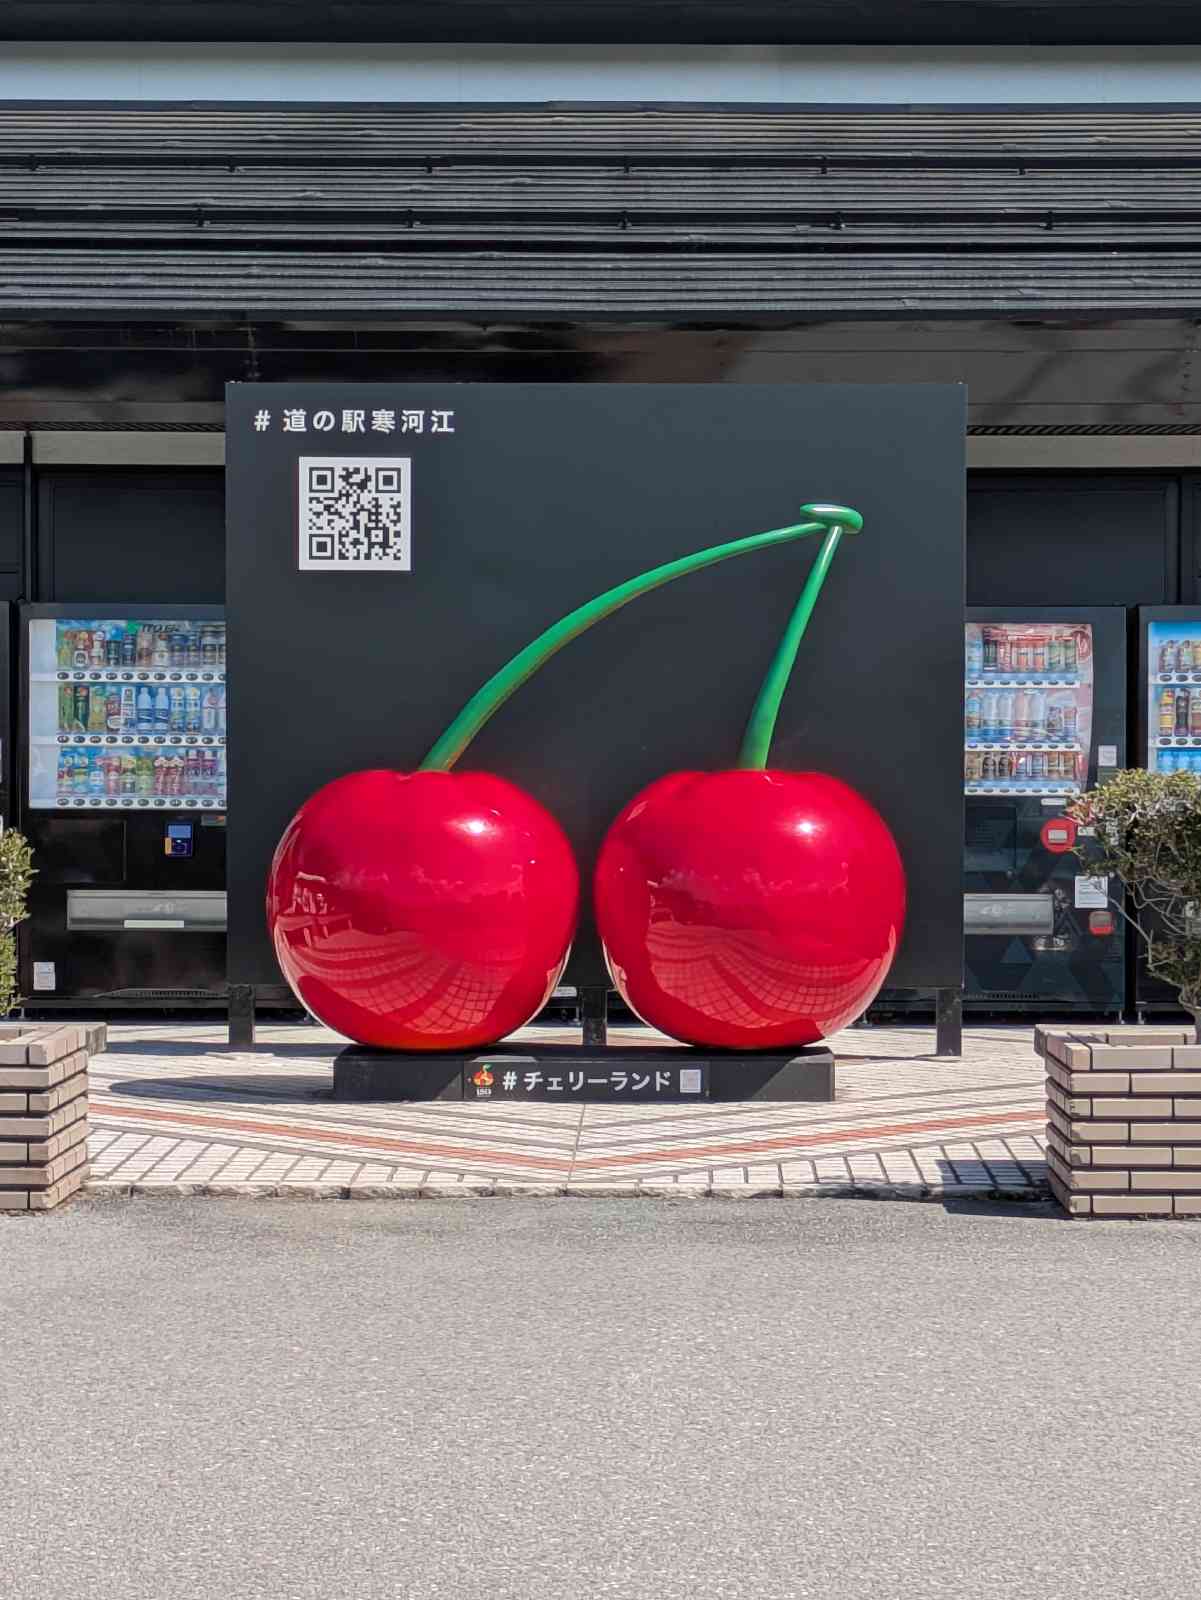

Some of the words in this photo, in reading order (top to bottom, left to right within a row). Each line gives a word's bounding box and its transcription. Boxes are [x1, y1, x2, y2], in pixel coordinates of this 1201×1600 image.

[283, 409, 455, 433] 道の駅寒河江
[524, 1071, 671, 1091] チェリーランド
